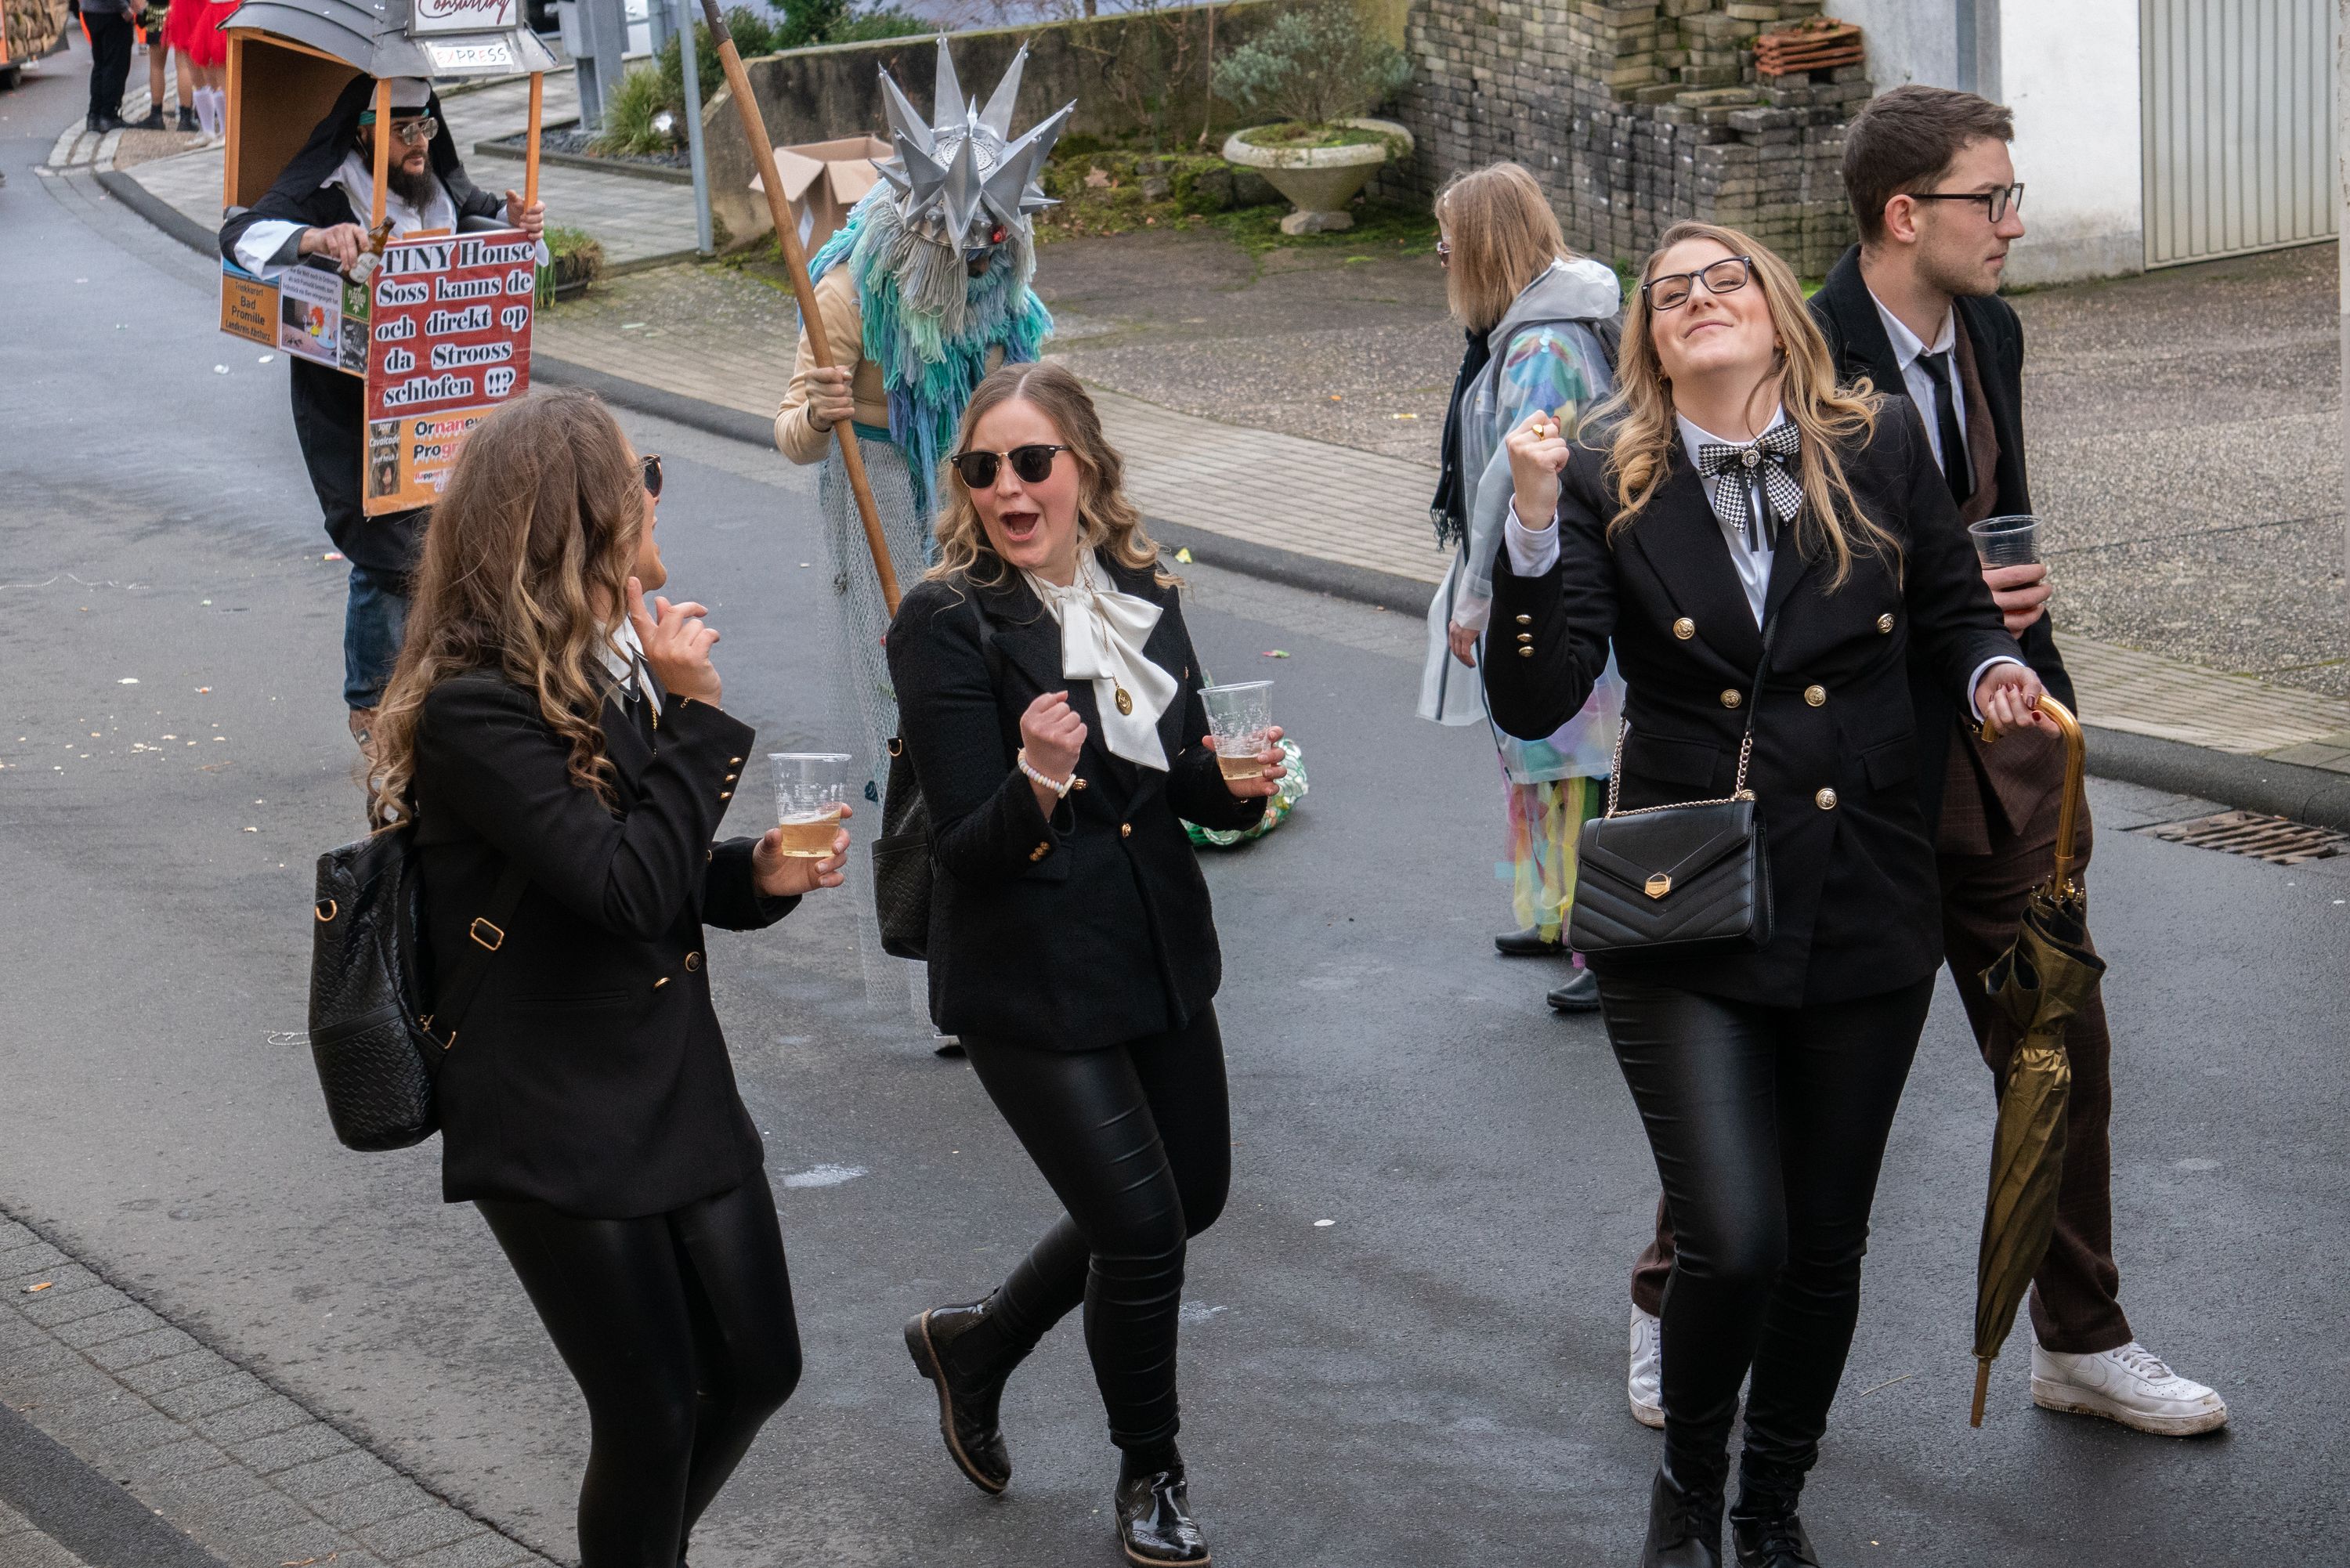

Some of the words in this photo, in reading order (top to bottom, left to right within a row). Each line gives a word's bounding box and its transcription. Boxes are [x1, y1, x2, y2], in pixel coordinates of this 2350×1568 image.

[436, 47, 507, 63] EXPRESS
[385, 242, 455, 274] TINY
[459, 241, 534, 266] House
[379, 282, 428, 305] Soss
[437, 278, 501, 300] kanns
[507, 271, 531, 294] de
[231, 305, 266, 326] Promille
[240, 295, 257, 310] Bad
[225, 319, 249, 333] Landkreis
[377, 316, 414, 340] och
[426, 308, 491, 334] direkt
[502, 307, 528, 330] op
[386, 349, 413, 370] da
[432, 344, 512, 367] Strooss
[384, 376, 472, 405] schlofen
[488, 370, 514, 395] !!?
